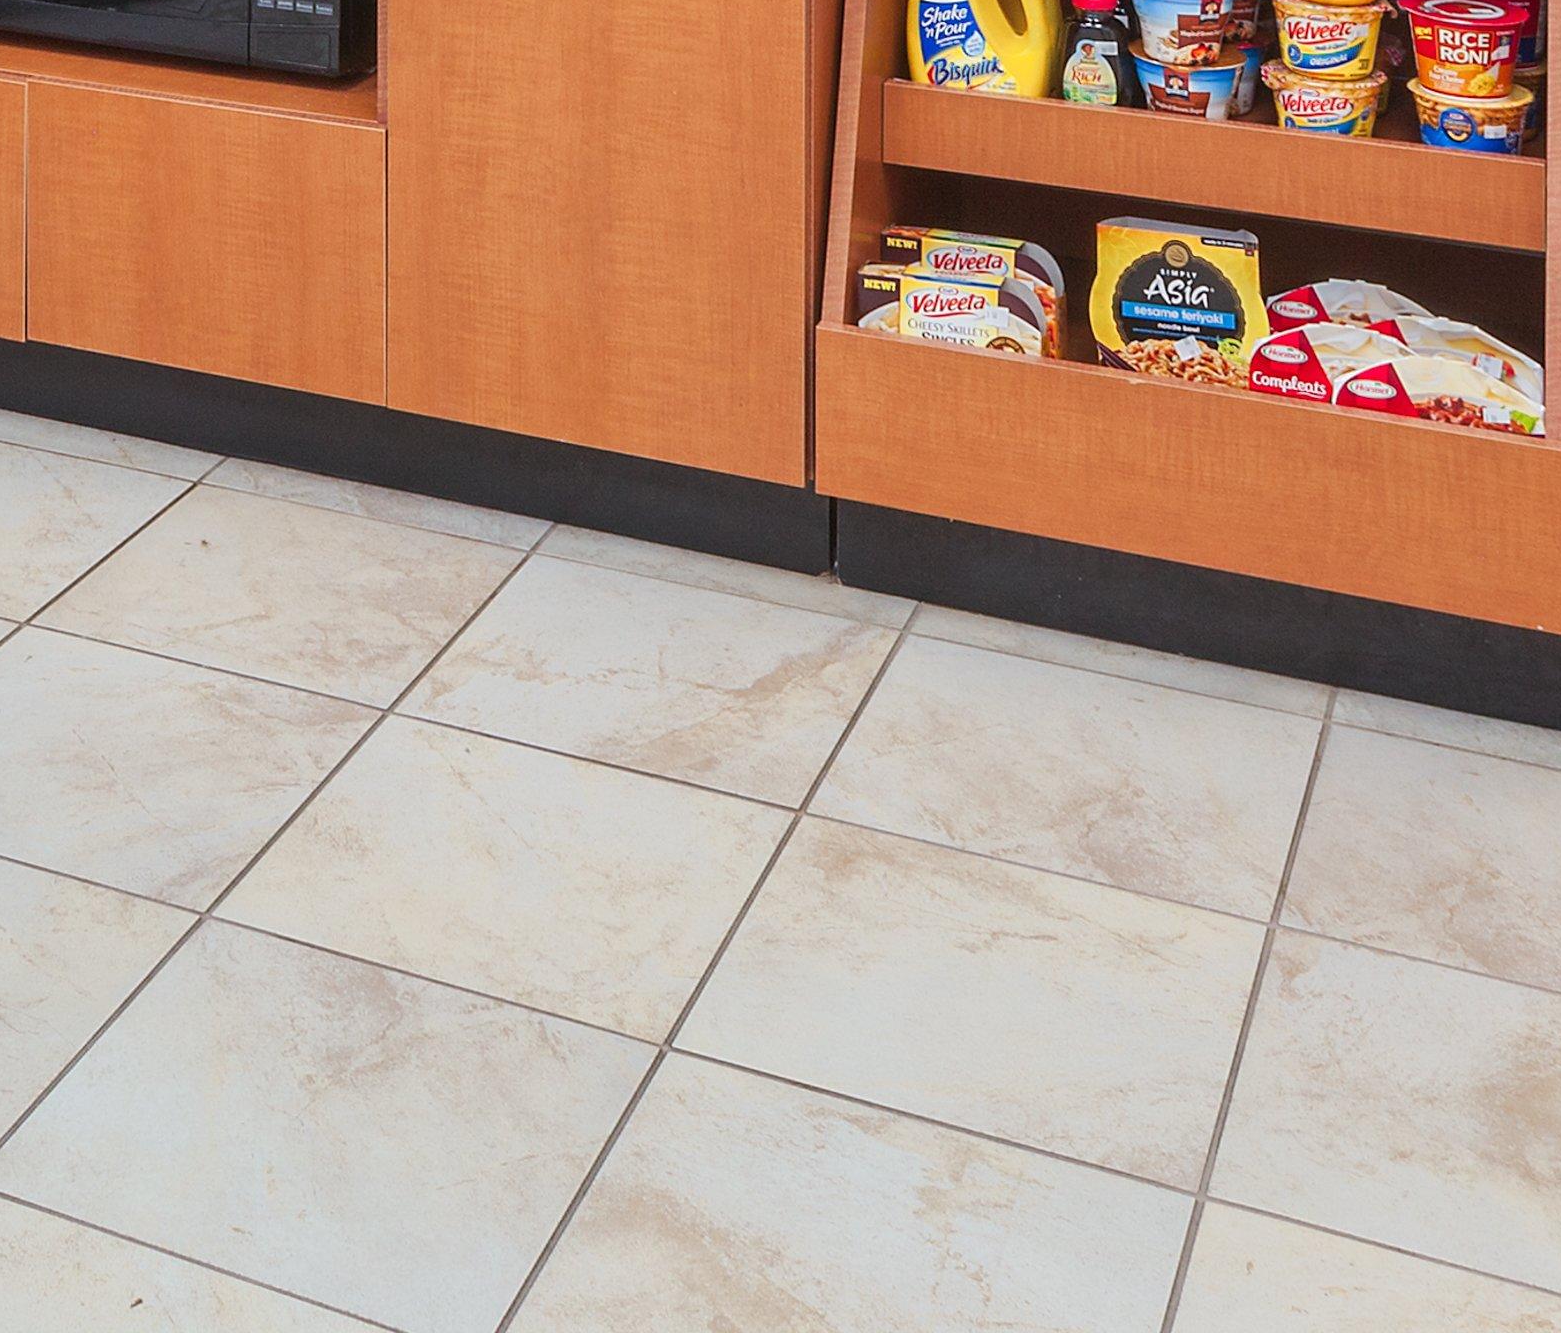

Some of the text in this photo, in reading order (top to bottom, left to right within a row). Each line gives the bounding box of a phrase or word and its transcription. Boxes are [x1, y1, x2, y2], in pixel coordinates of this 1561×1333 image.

[922, 4, 968, 28] Shake
[934, 21, 972, 37] Pour
[1438, 30, 1490, 46] RICE
[1440, 49, 1489, 64] RONI
[933, 56, 1004, 86] Bisquick
[1281, 94, 1348, 112] Velveeta
[886, 238, 920, 251] NEW!
[930, 253, 1004, 276] Velveeta
[1160, 268, 1198, 279] SIMPLY
[863, 279, 896, 293] NEW!
[1142, 275, 1209, 306] Asia
[912, 291, 987, 317] Velveeta
[1133, 303, 1225, 325] sesame teriyaki
[908, 318, 990, 339] CHEESY SKILLETS
[1260, 347, 1308, 364] Hormel
[1251, 370, 1328, 397] Compleats
[1352, 382, 1396, 398] Hormel
